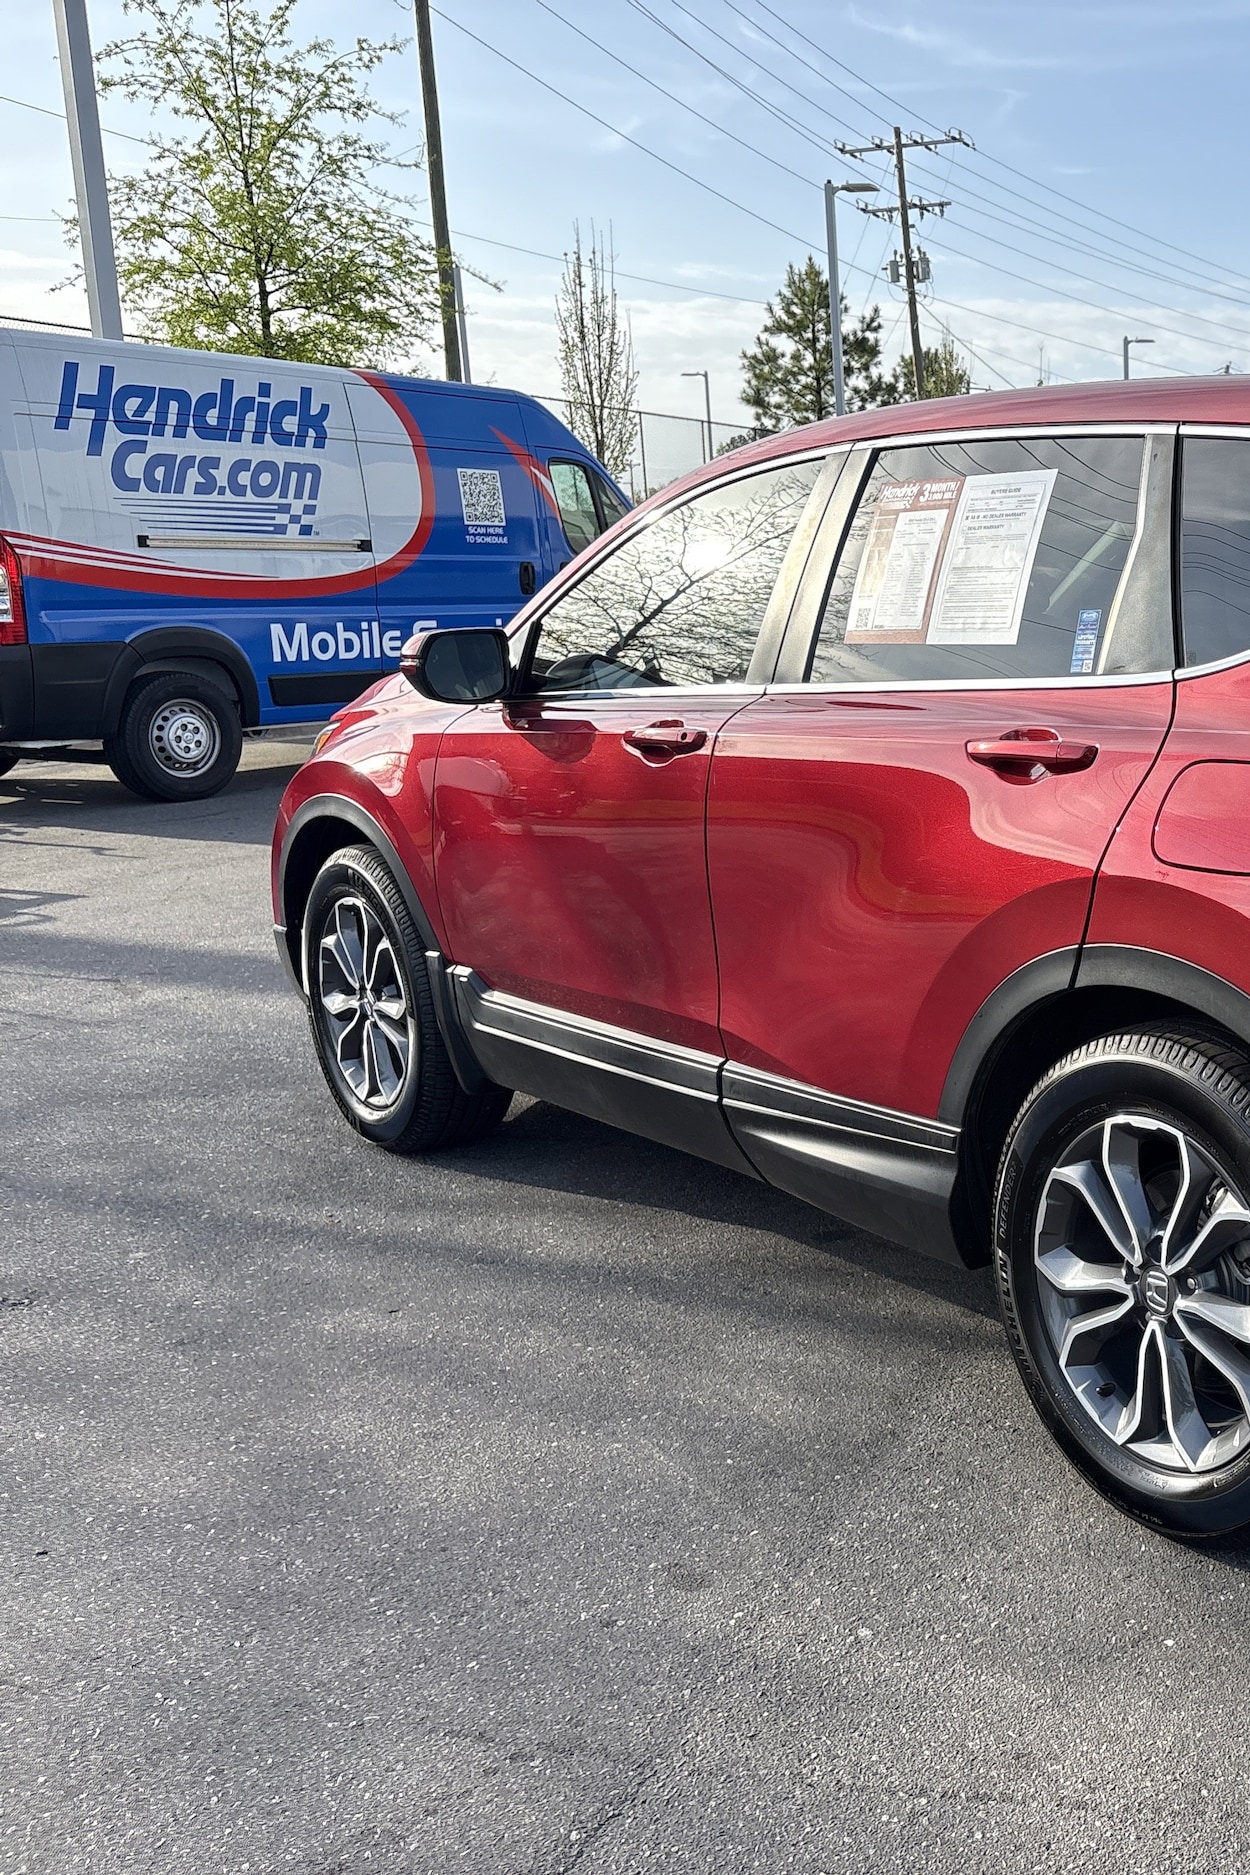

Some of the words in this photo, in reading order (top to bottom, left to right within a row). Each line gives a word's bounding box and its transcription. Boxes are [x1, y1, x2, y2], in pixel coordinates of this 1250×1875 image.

[54, 361, 330, 456] Hendrick
[111, 440, 321, 500] Cars.com
[919, 483, 931, 502] 3
[468, 526, 486, 534] SCAN
[475, 536, 508, 544] SCHEDULE
[269, 620, 401, 663] Mobile
